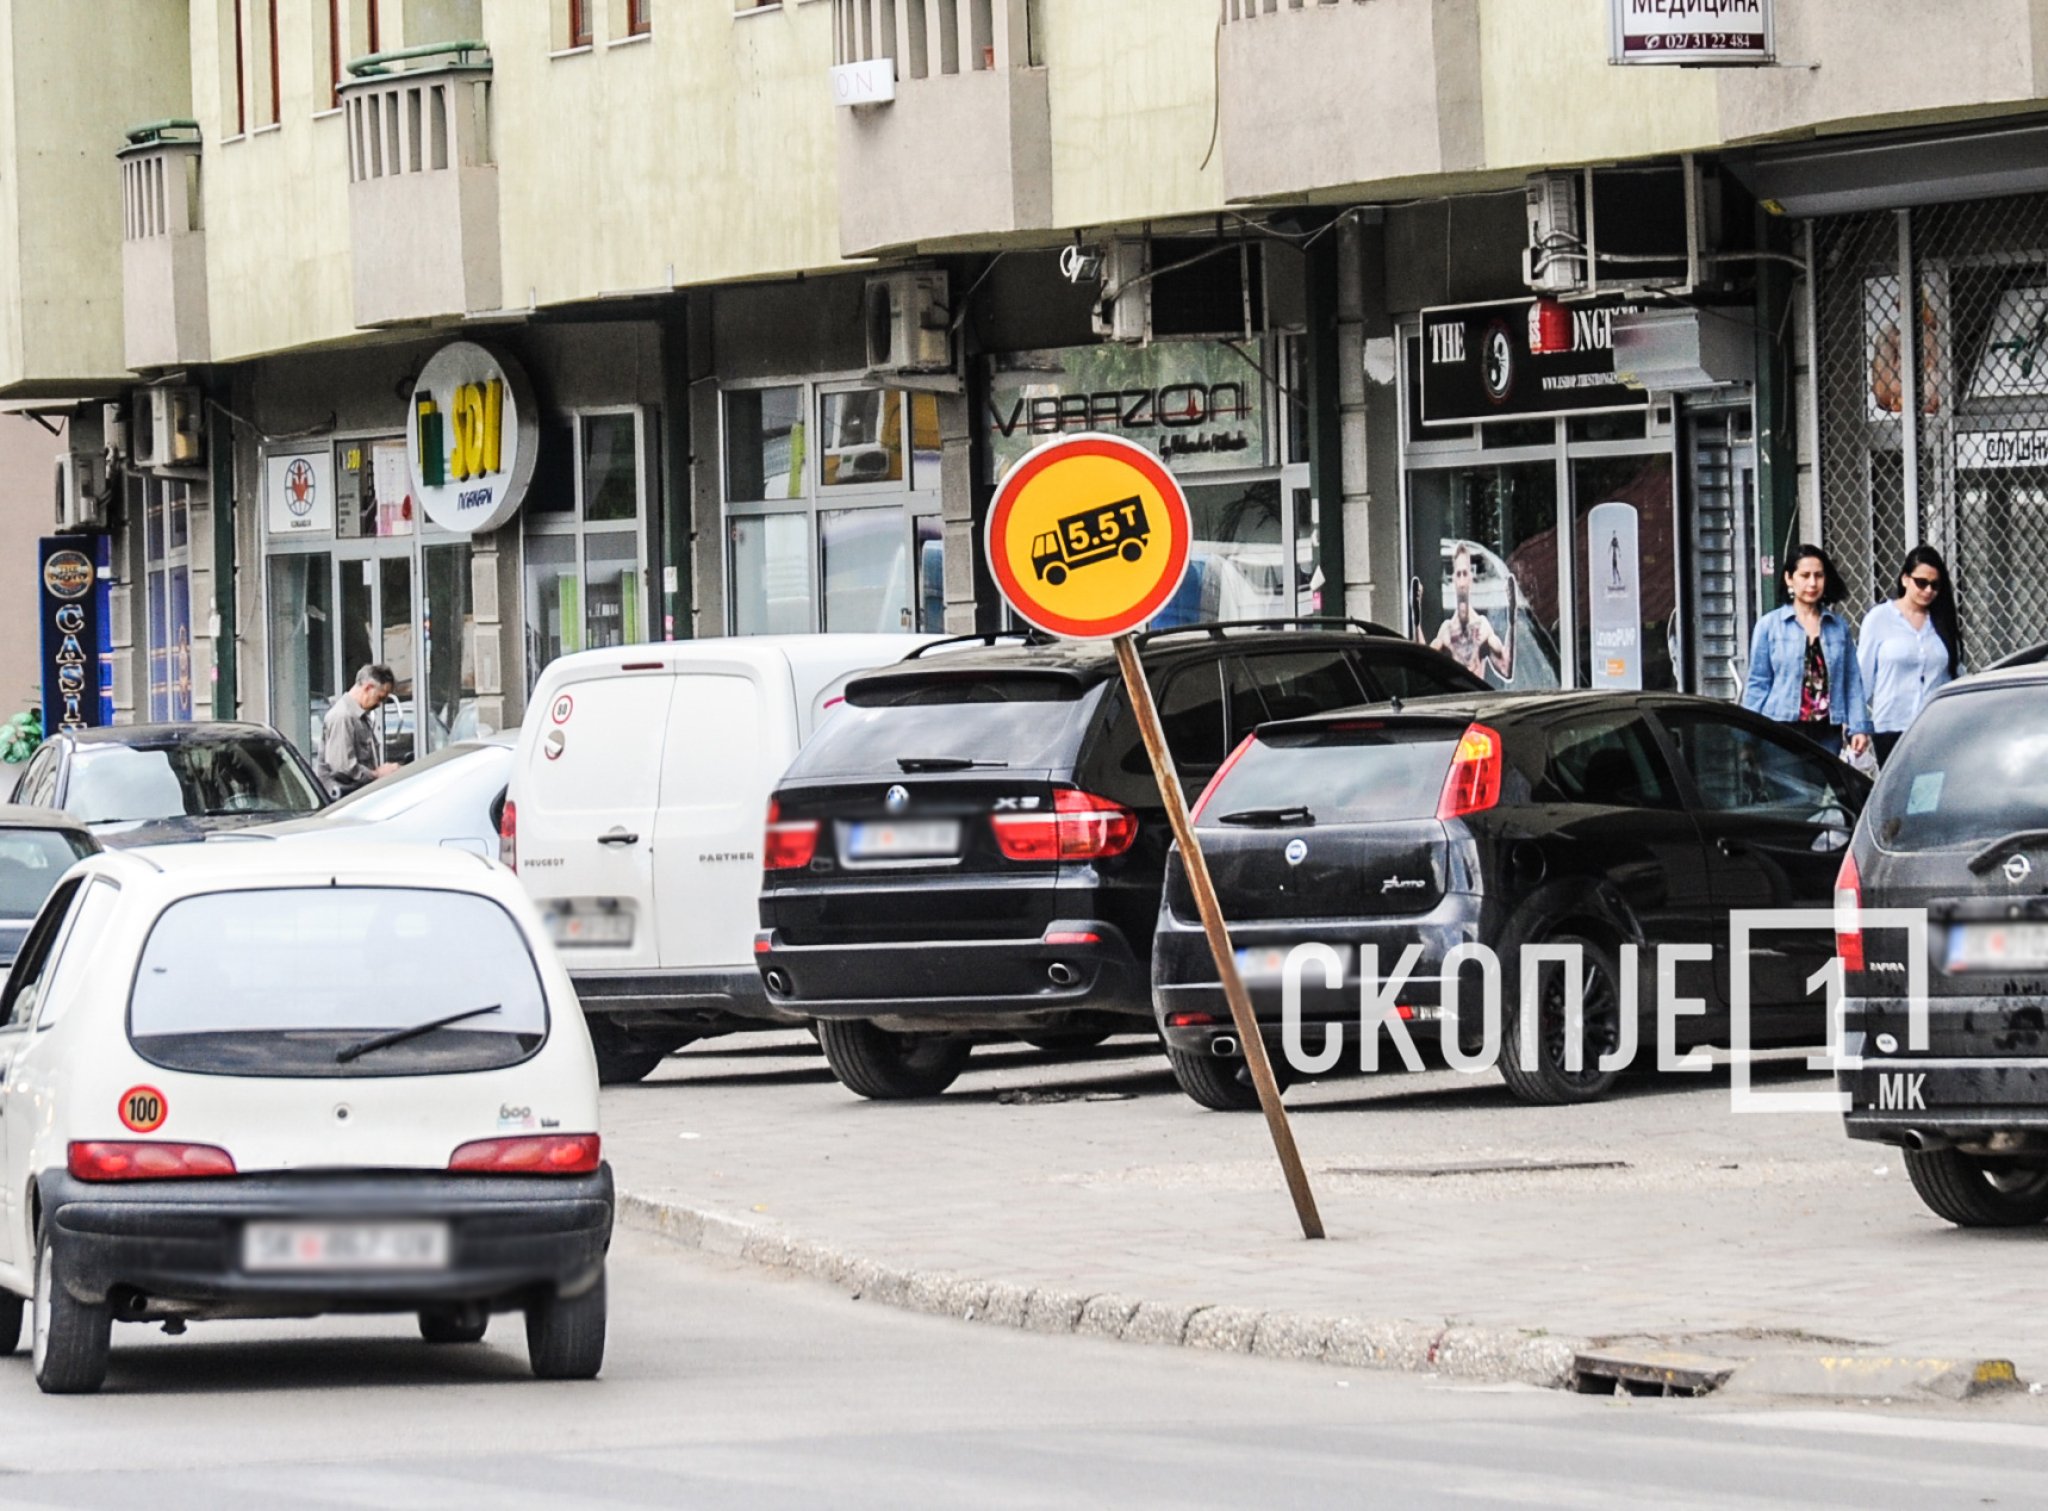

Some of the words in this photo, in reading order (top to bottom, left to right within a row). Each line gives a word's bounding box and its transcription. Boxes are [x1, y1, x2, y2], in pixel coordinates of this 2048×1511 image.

[1692, 33, 1707, 48] 31
[1711, 33, 1726, 48] 22
[1430, 322, 1466, 363] THE
[451, 378, 501, 480] SDI
[523, 858, 565, 868] PEUGEOT
[698, 852, 755, 863] PARTNER
[129, 1096, 158, 1122] 100
[500, 1102, 531, 1120] 600
